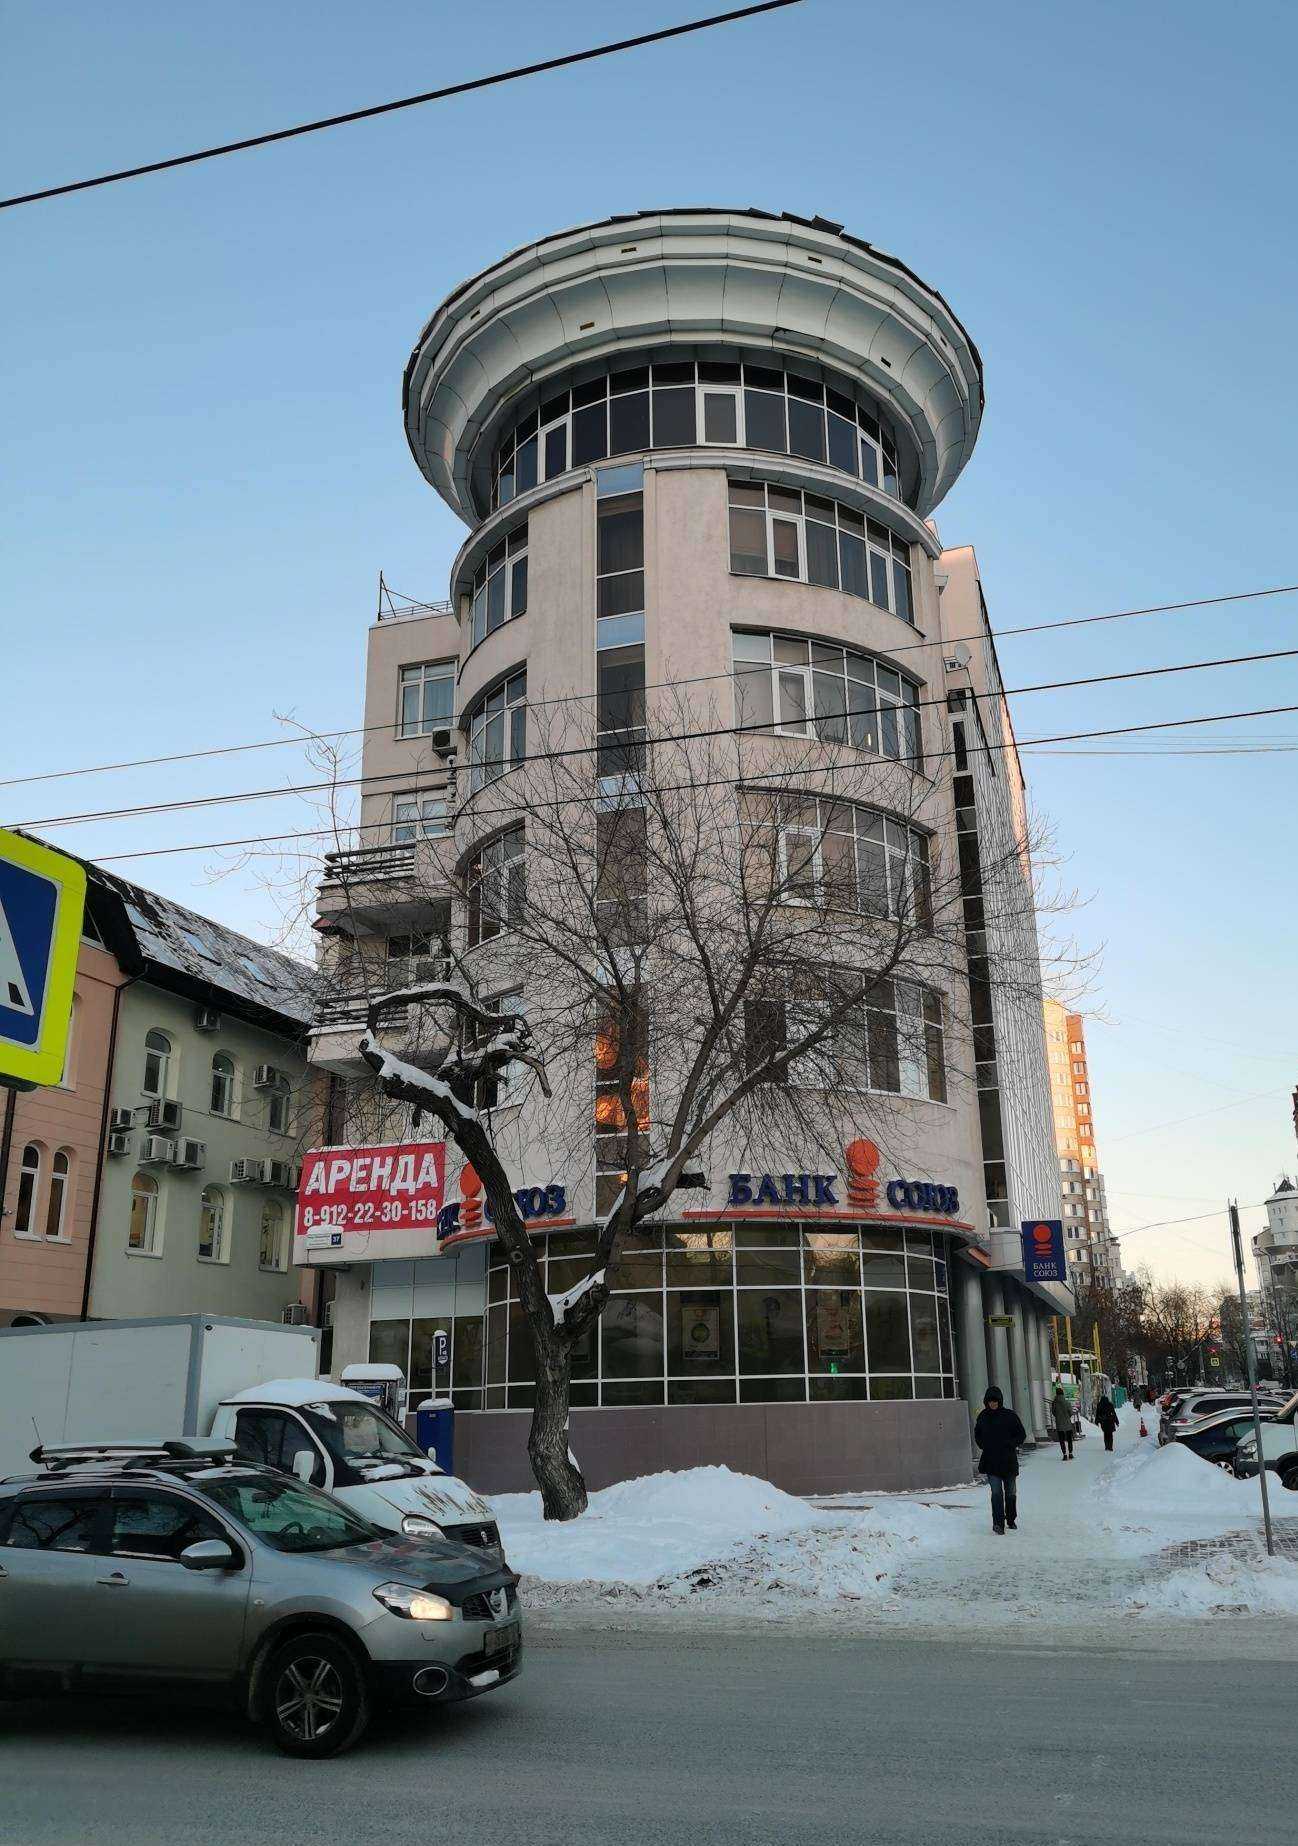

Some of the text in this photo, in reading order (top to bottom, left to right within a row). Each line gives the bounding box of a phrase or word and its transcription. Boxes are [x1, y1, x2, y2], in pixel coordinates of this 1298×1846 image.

[304, 1153, 438, 1196] АРЕНДА
[728, 1173, 960, 1214] БАНК СОЮЗ
[303, 1198, 437, 1227] 8-912-22-30-158
[1033, 1262, 1057, 1270] БАНК
[1033, 1269, 1058, 1277] СОЮЗ
